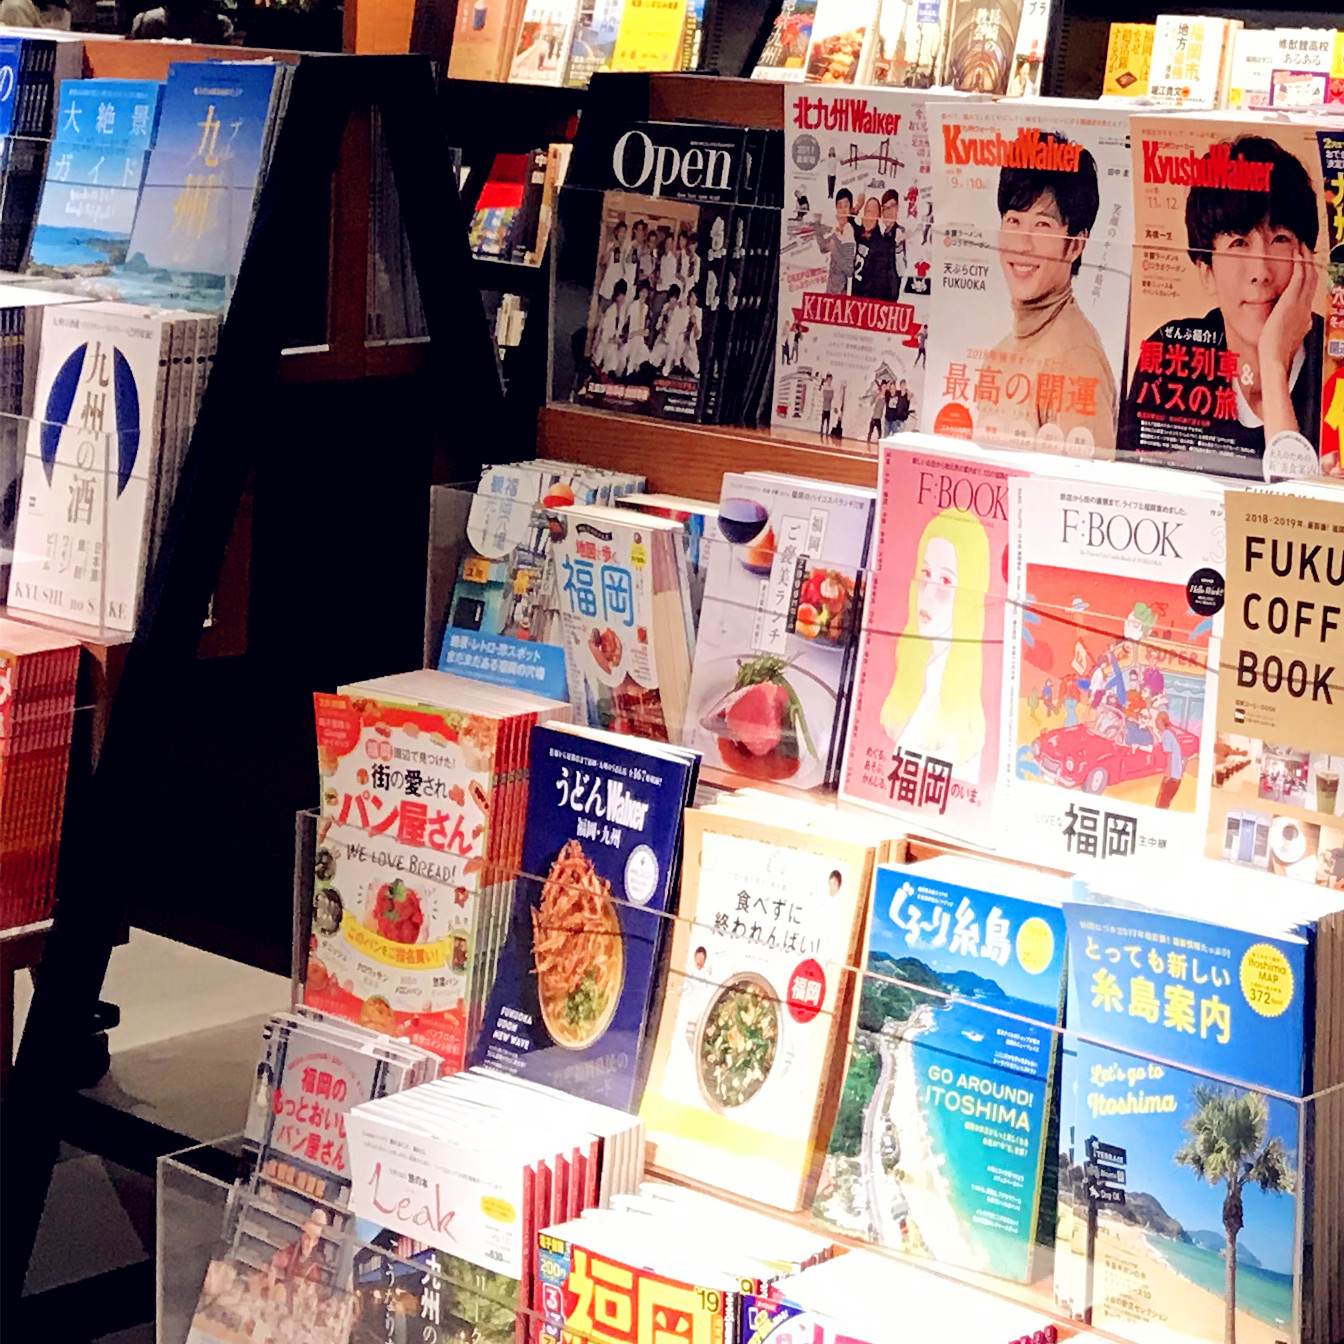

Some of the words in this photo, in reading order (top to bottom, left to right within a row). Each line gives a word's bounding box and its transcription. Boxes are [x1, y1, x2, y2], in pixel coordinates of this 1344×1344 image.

[63, 100, 150, 137] 大絶景
[792, 96, 901, 136] 北九州Walker
[55, 154, 135, 189] ガイド
[169, 104, 220, 241] 九州
[612, 129, 732, 200] Open
[942, 278, 986, 292] FUKUOKA
[943, 262, 989, 277] 天ぷらCITY
[803, 295, 913, 333] KITAKYUSHU
[1164, 326, 1218, 345] ぜんぶ紹介!
[1140, 340, 1240, 381] 観光列車
[1240, 364, 1254, 385] &
[942, 362, 1100, 416] 最高の開運
[1136, 380, 1238, 422] バスの旅
[66, 339, 111, 528] 九州の酒
[917, 471, 1009, 521] F:BOOK
[808, 515, 823, 554] 福岡
[1061, 507, 1183, 559] F:BOOK
[14, 579, 65, 612] KYUSHU
[70, 598, 84, 613] no
[562, 554, 634, 627] 福岡
[769, 524, 801, 645] ご褒美ランチ
[1237, 650, 1336, 705] BOOK
[371, 763, 448, 800] 街の愛され
[556, 766, 649, 832] うどんWalker
[339, 790, 473, 856] パン屋さん
[577, 816, 622, 849] 福岡・九州
[347, 843, 370, 861] WE
[372, 852, 405, 871] LOVE
[409, 855, 456, 882] BREAD!
[736, 889, 804, 926] 食べずに
[712, 910, 821, 956] 終われんばい!
[1085, 935, 1231, 987] とっても新しい
[1248, 957, 1287, 975] Itoshima
[1258, 971, 1279, 984] MAP
[791, 976, 820, 1007] 福岡
[1091, 967, 1231, 1045] 糸島案内
[1250, 989, 1271, 1005] 372
[496, 1018, 518, 1033] UDON
[500, 1006, 533, 1026] FUKUOKA
[493, 1030, 509, 1042] NEW
[510, 1035, 530, 1051] WAVE
[302, 1066, 347, 1103] 福岡の
[928, 1064, 953, 1086] GO
[956, 1073, 1034, 1109] AROUND!
[1090, 1062, 1125, 1087] Let's
[1127, 1067, 1146, 1087] go
[1148, 1063, 1164, 1080] to
[925, 1087, 1031, 1133] ITOSHIMA
[1087, 1090, 1177, 1119] Itoshima
[277, 1126, 345, 1172] パン屋さん
[368, 1162, 456, 1243] Leak
[421, 1254, 441, 1343] 九州の
